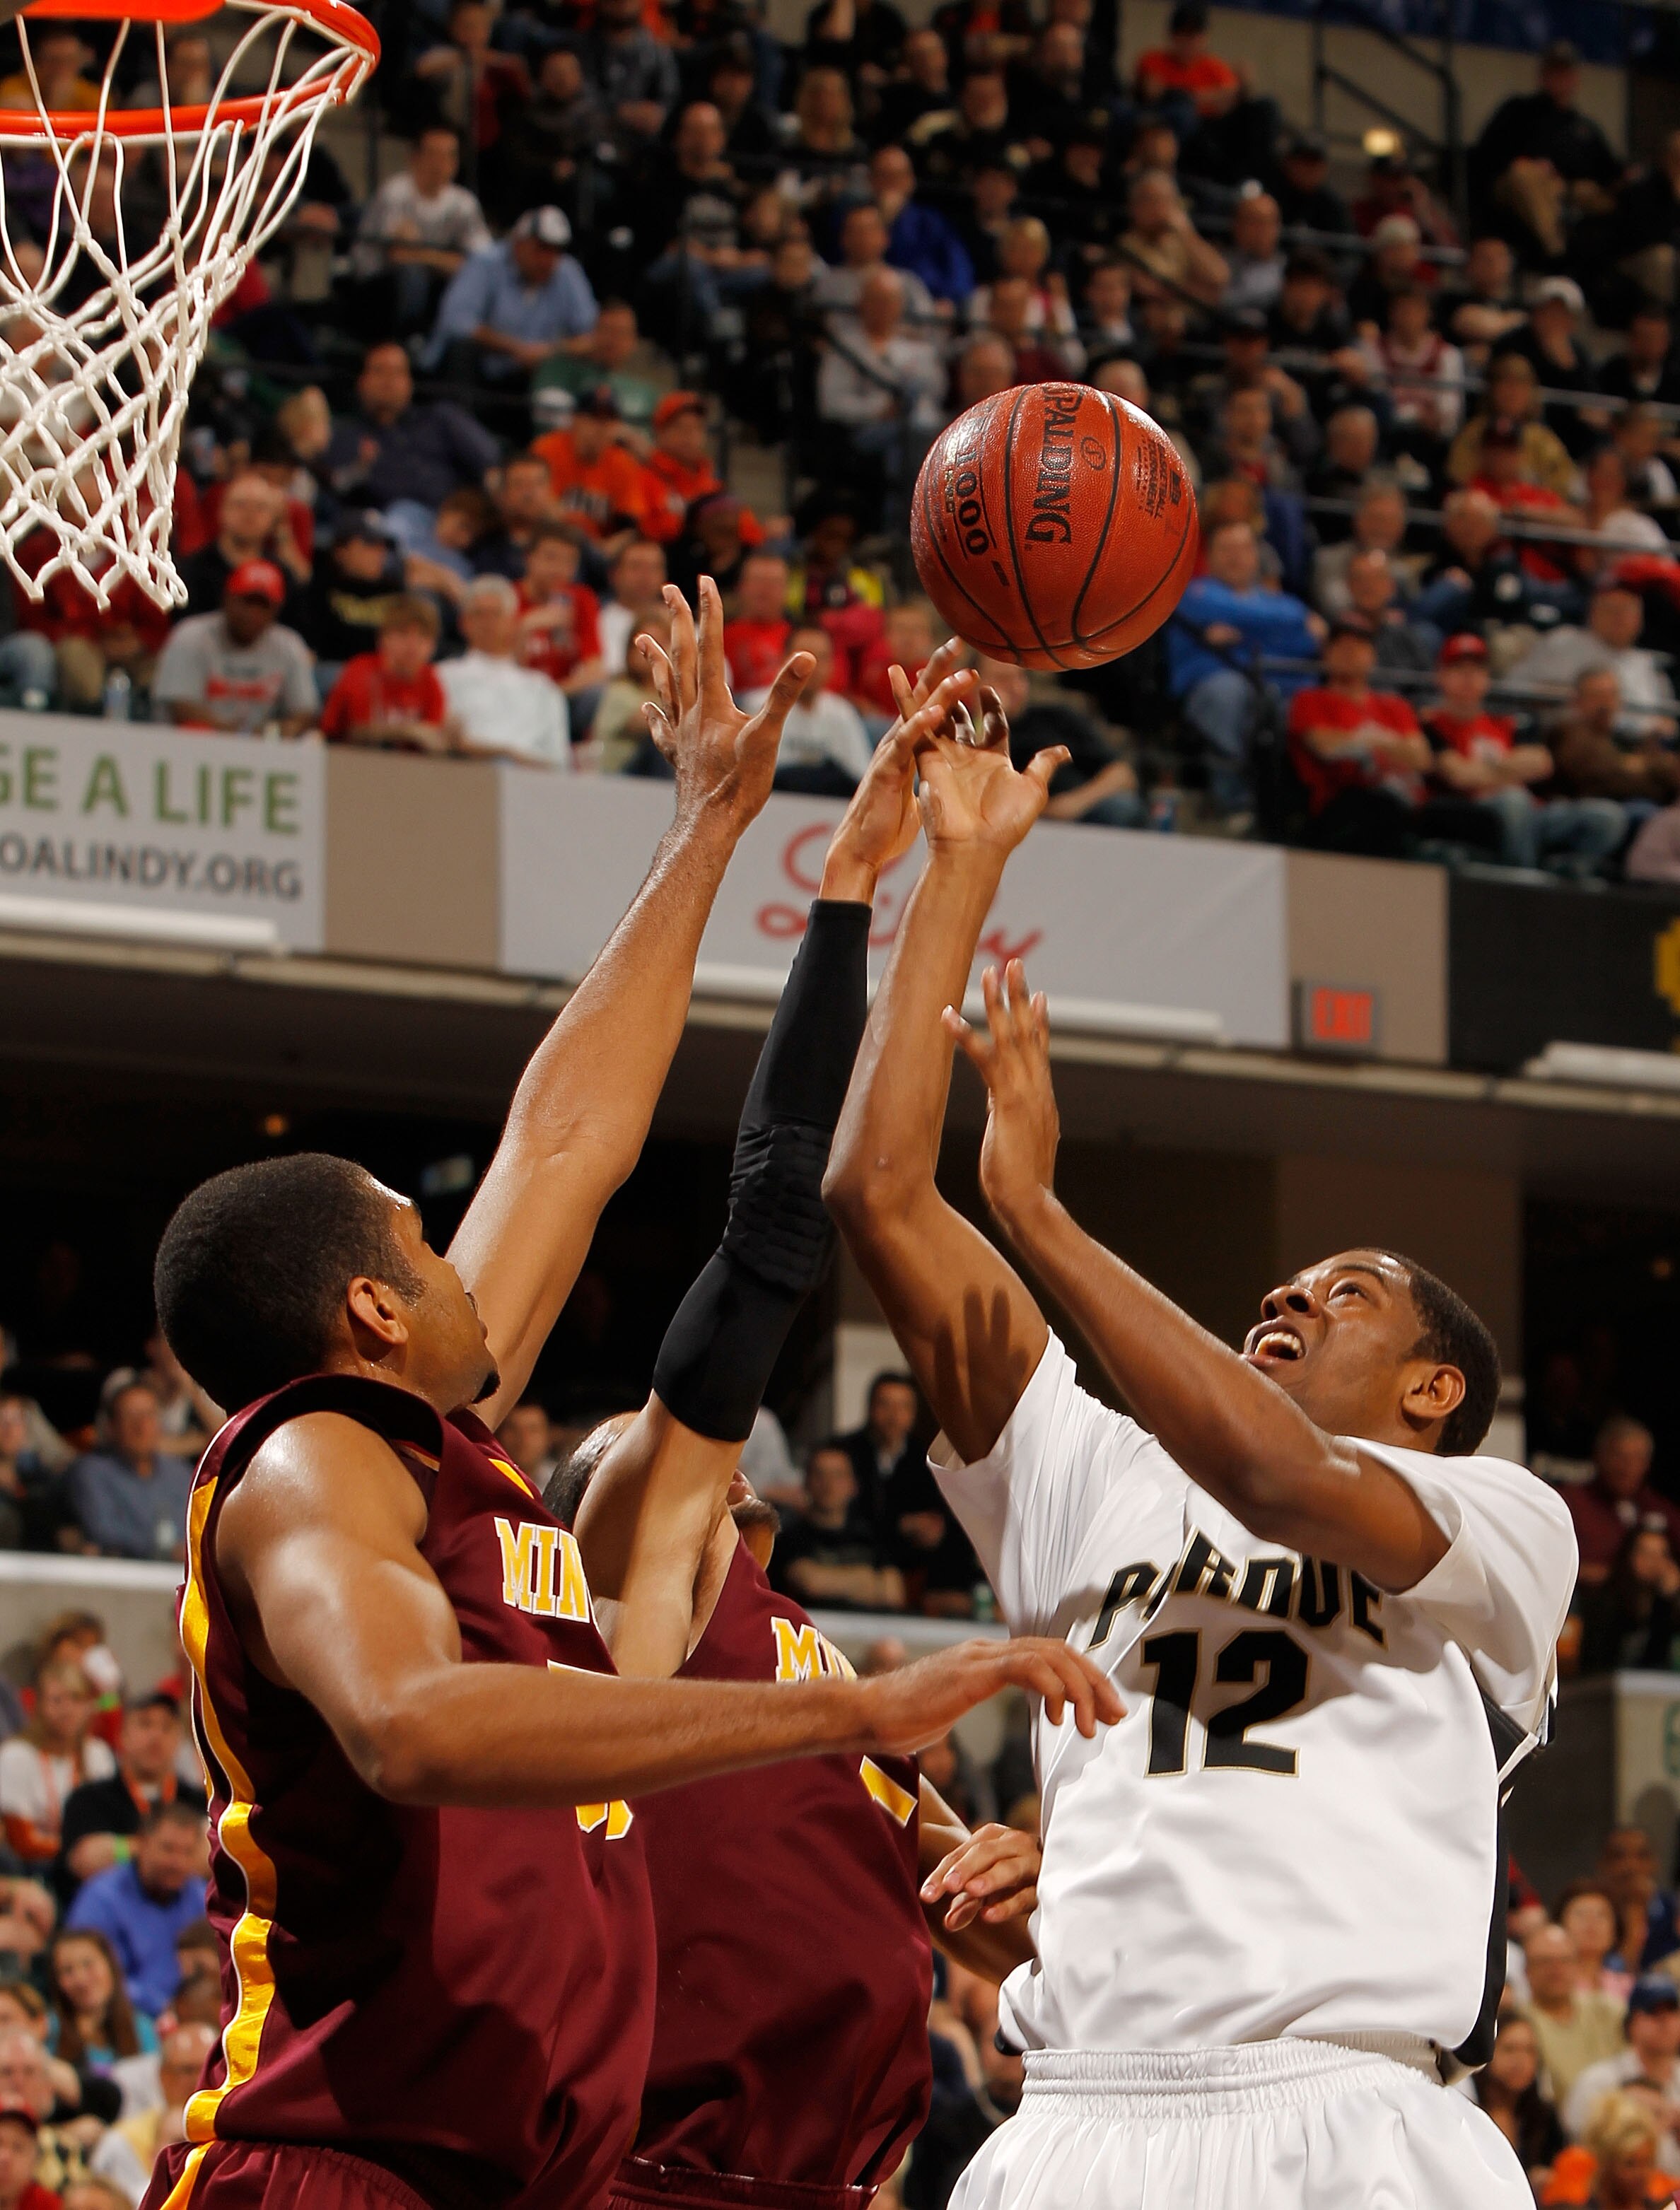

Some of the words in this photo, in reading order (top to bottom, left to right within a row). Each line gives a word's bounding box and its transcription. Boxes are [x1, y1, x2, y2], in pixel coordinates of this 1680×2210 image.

[79, 751, 130, 819] A
[154, 758, 303, 836] LIFE
[1312, 986, 1373, 1043] EXIT
[1140, 1627, 1311, 1778] 12
